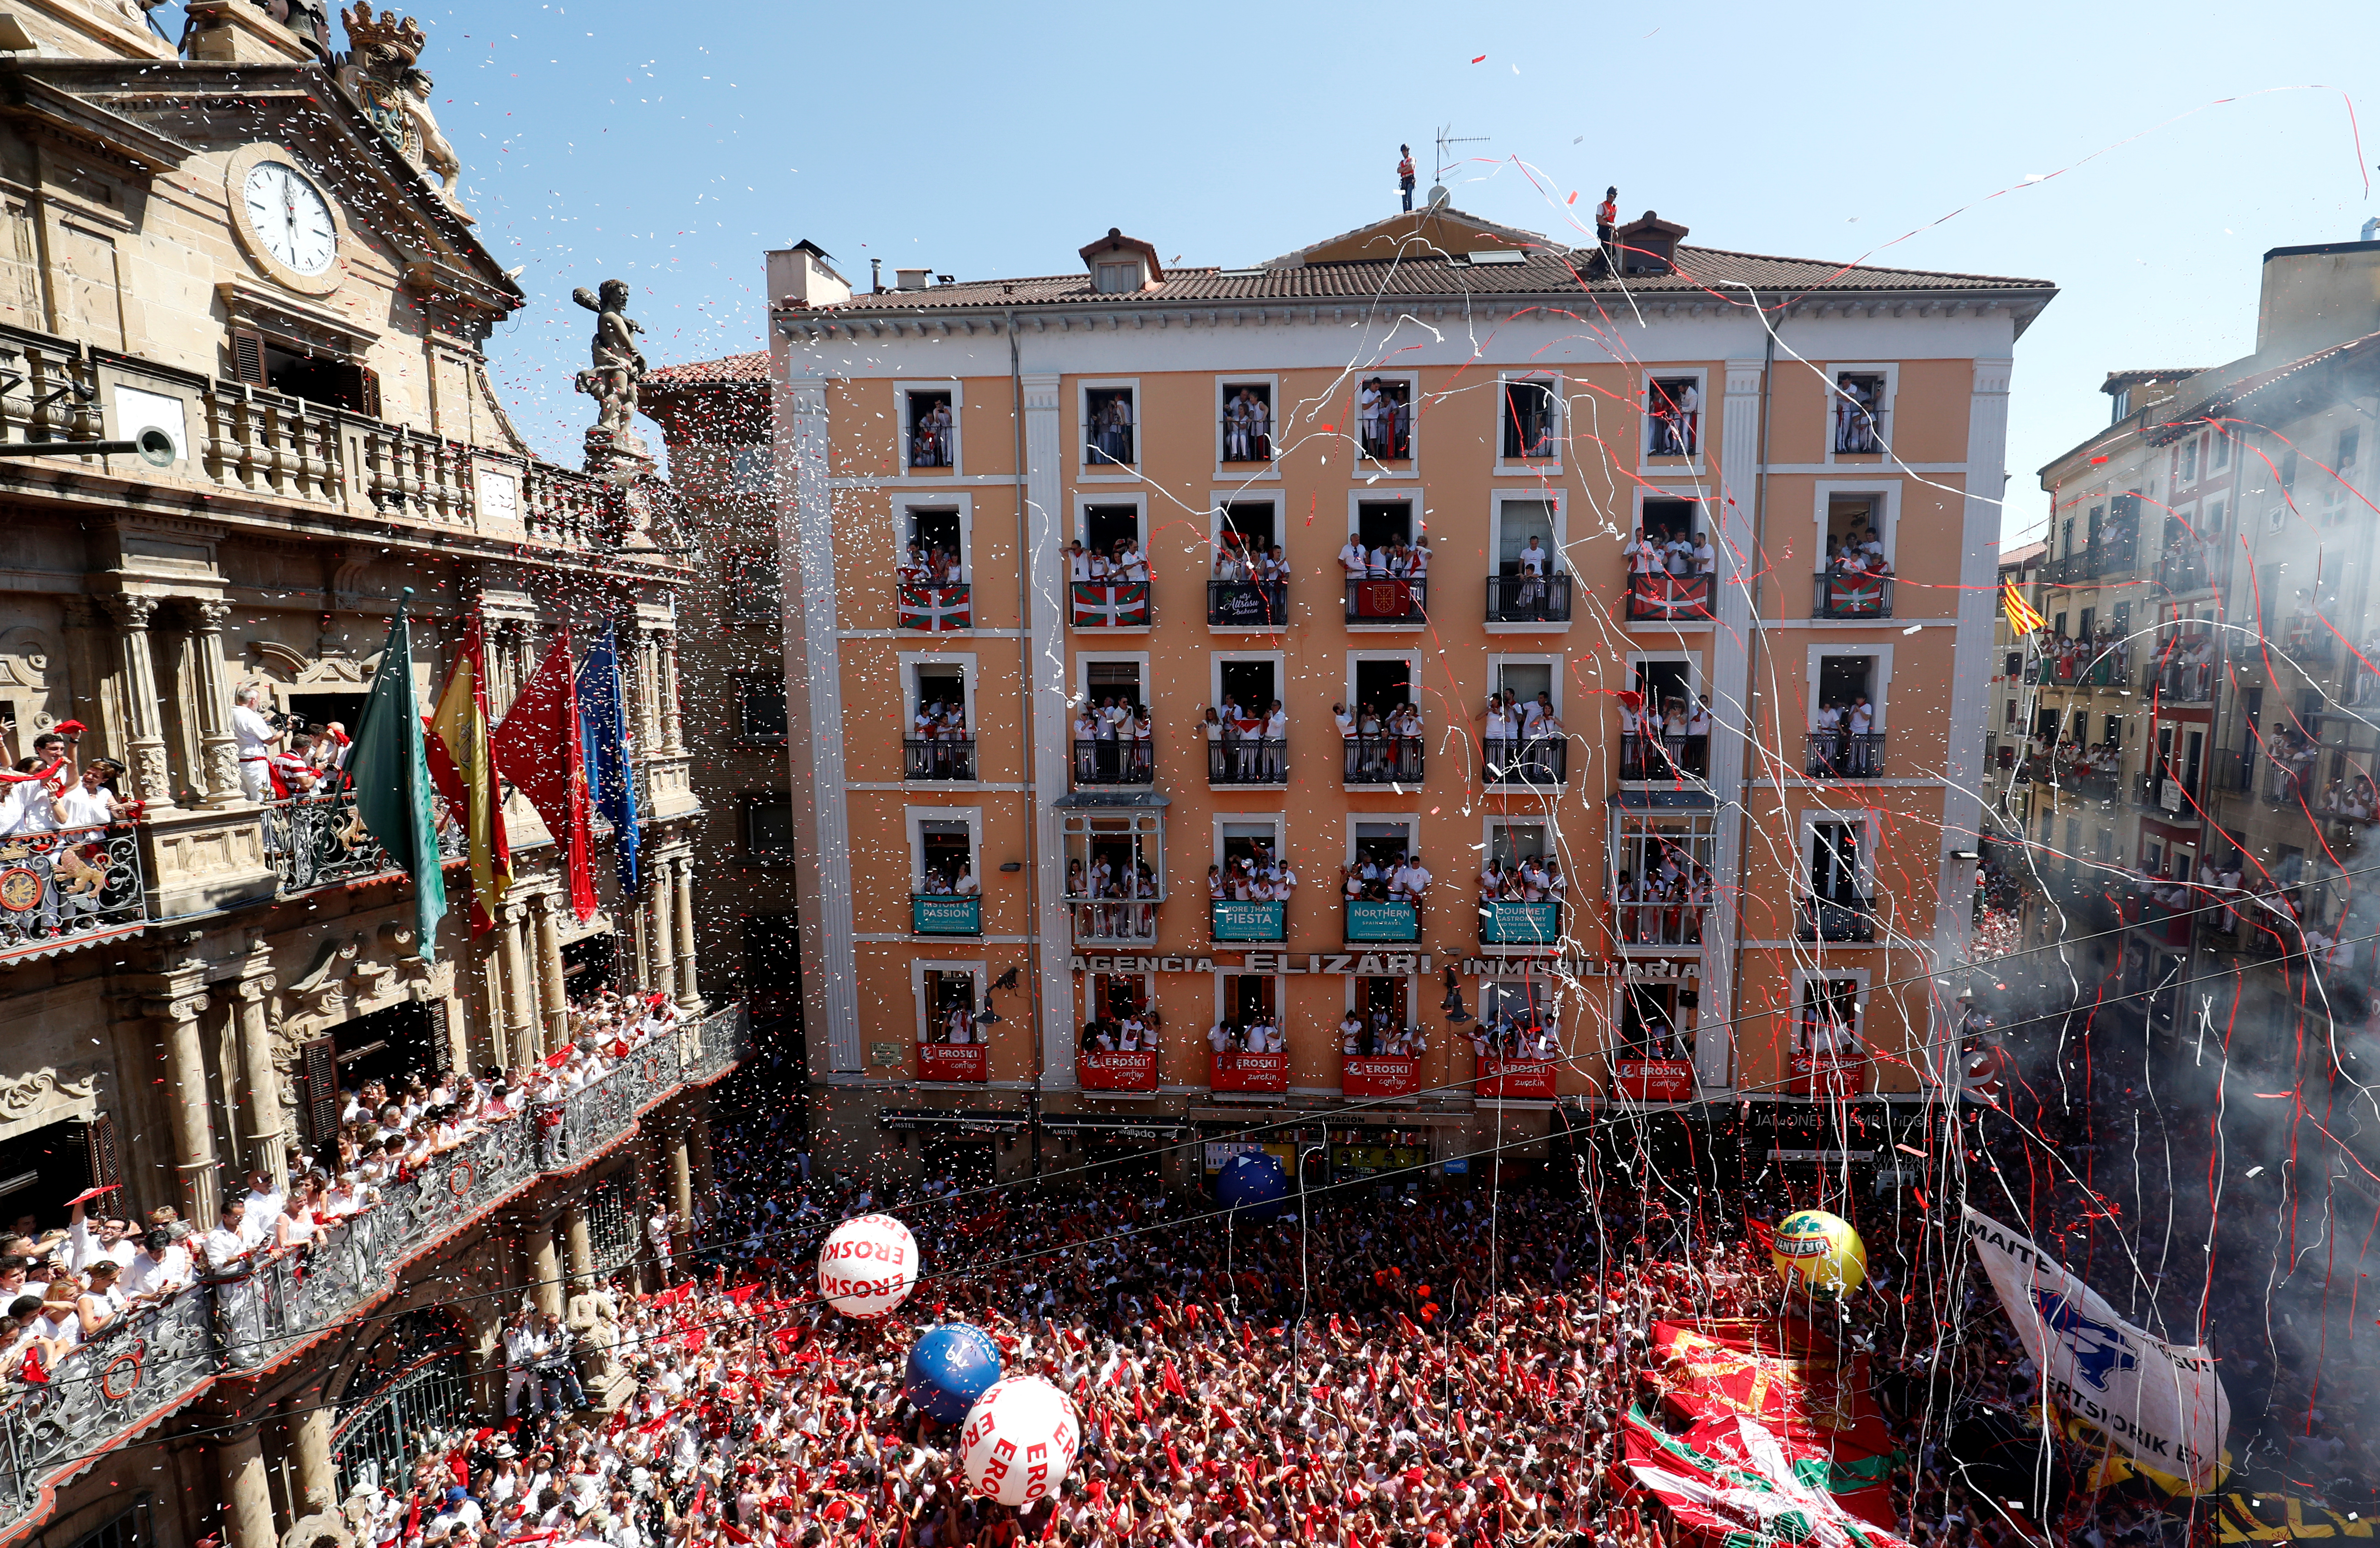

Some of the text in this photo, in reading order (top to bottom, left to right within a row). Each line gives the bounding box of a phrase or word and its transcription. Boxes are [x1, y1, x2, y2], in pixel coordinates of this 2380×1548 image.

[1240, 592, 1251, 601] utzi
[1224, 597, 1259, 611] Altsasu
[923, 909, 969, 917] PASSION
[1354, 907, 1410, 919] NORTHERN
[1226, 914, 1273, 924] FIESTA
[1067, 956, 1216, 972] AGENCIA
[1245, 955, 1431, 974] ELIZARI
[1462, 959, 1702, 978] INMOBILIARIA
[951, 1062, 976, 1073] contigo
[1105, 1058, 1145, 1066] EROSKI
[1816, 1060, 1857, 1069] EROSKI
[1367, 1065, 1408, 1073] EROSKI
[1504, 1065, 1545, 1073] EROSKI
[1640, 1067, 1682, 1075] EROSKI
[1118, 1069, 1145, 1082] contigo
[1379, 1077, 1406, 1090] contigo
[1514, 1079, 1544, 1087] zurekin
[1652, 1079, 1680, 1091] contigo
[1295, 1115, 1364, 1123] ALIMENTACIÓN
[1755, 1115, 1825, 1126] JAMONES
[1871, 1163, 1941, 1172] SALAMANCA
[1968, 1219, 2051, 1274] MAITE
[822, 1241, 904, 1265] EROSKI
[821, 1271, 904, 1299] EROSKI
[939, 1324, 996, 1362] LIBERTAD
[946, 1340, 970, 1368] blu
